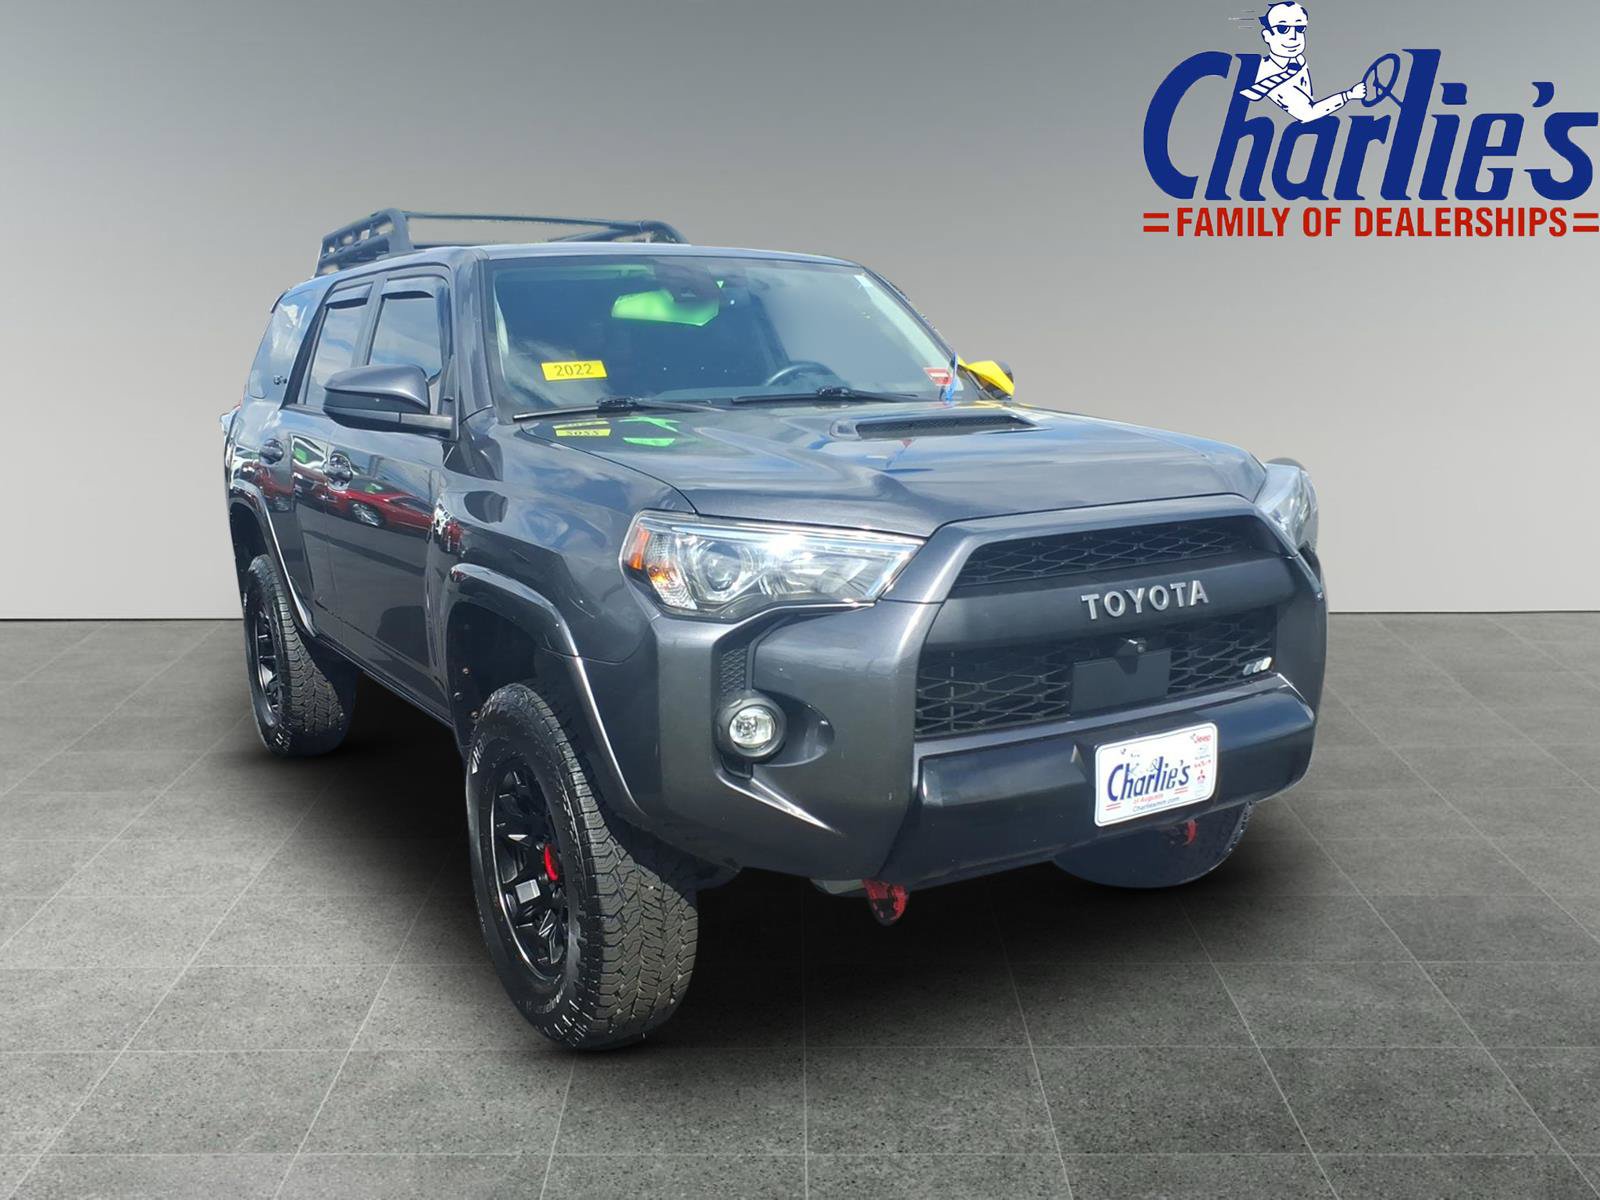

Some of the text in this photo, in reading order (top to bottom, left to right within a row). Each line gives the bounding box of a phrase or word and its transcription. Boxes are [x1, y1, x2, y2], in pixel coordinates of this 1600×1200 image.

[553, 363, 594, 377] 2022
[1081, 580, 1209, 620] TOYOTA
[1107, 756, 1191, 802] Charlie's
